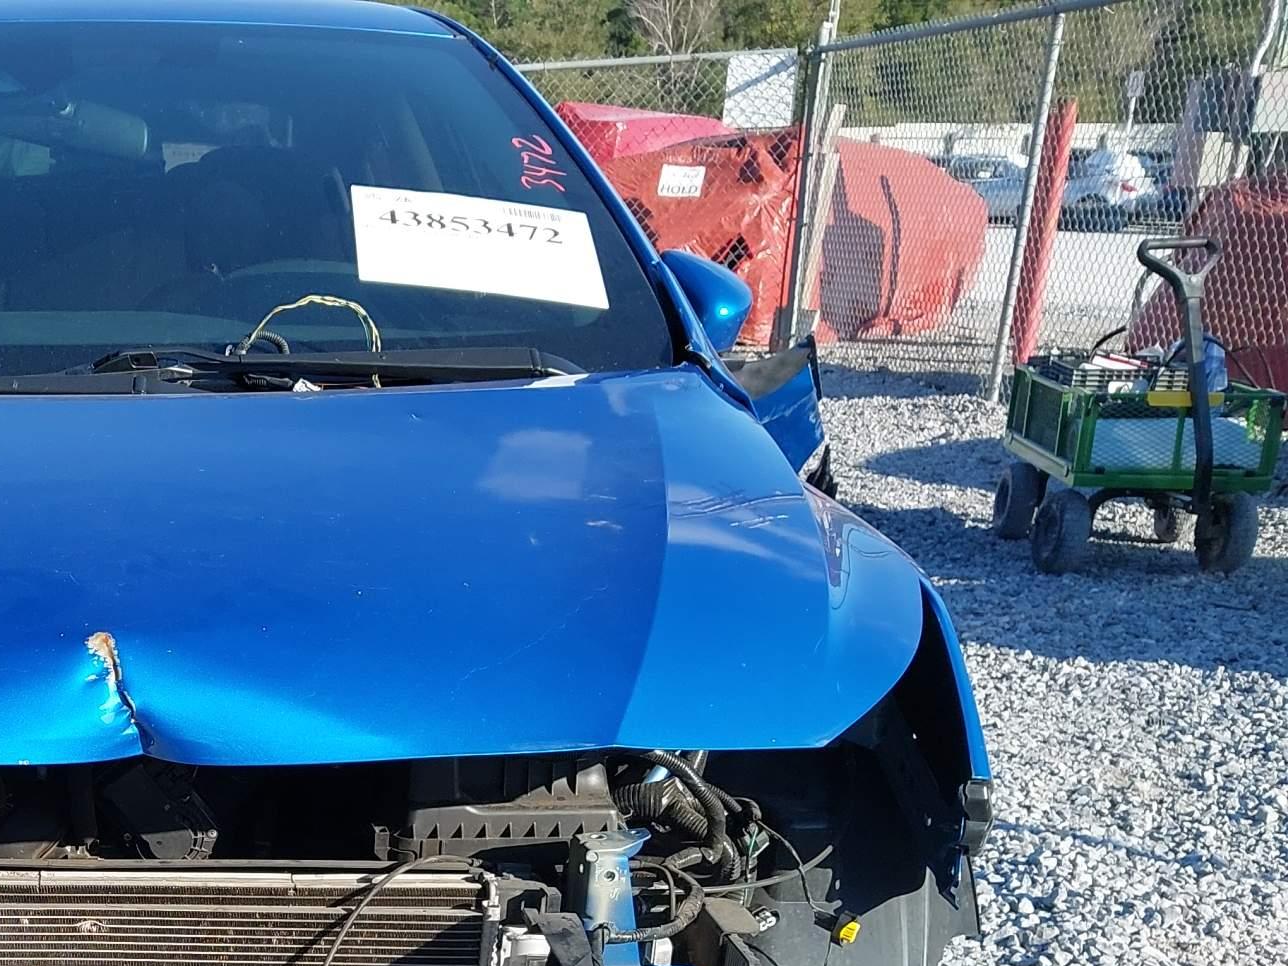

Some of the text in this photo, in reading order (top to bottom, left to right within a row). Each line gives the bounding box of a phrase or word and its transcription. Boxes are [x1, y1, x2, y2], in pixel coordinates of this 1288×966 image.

[511, 134, 567, 192] 3472
[660, 183, 698, 194] HOLD
[378, 209, 563, 244] 43853472
